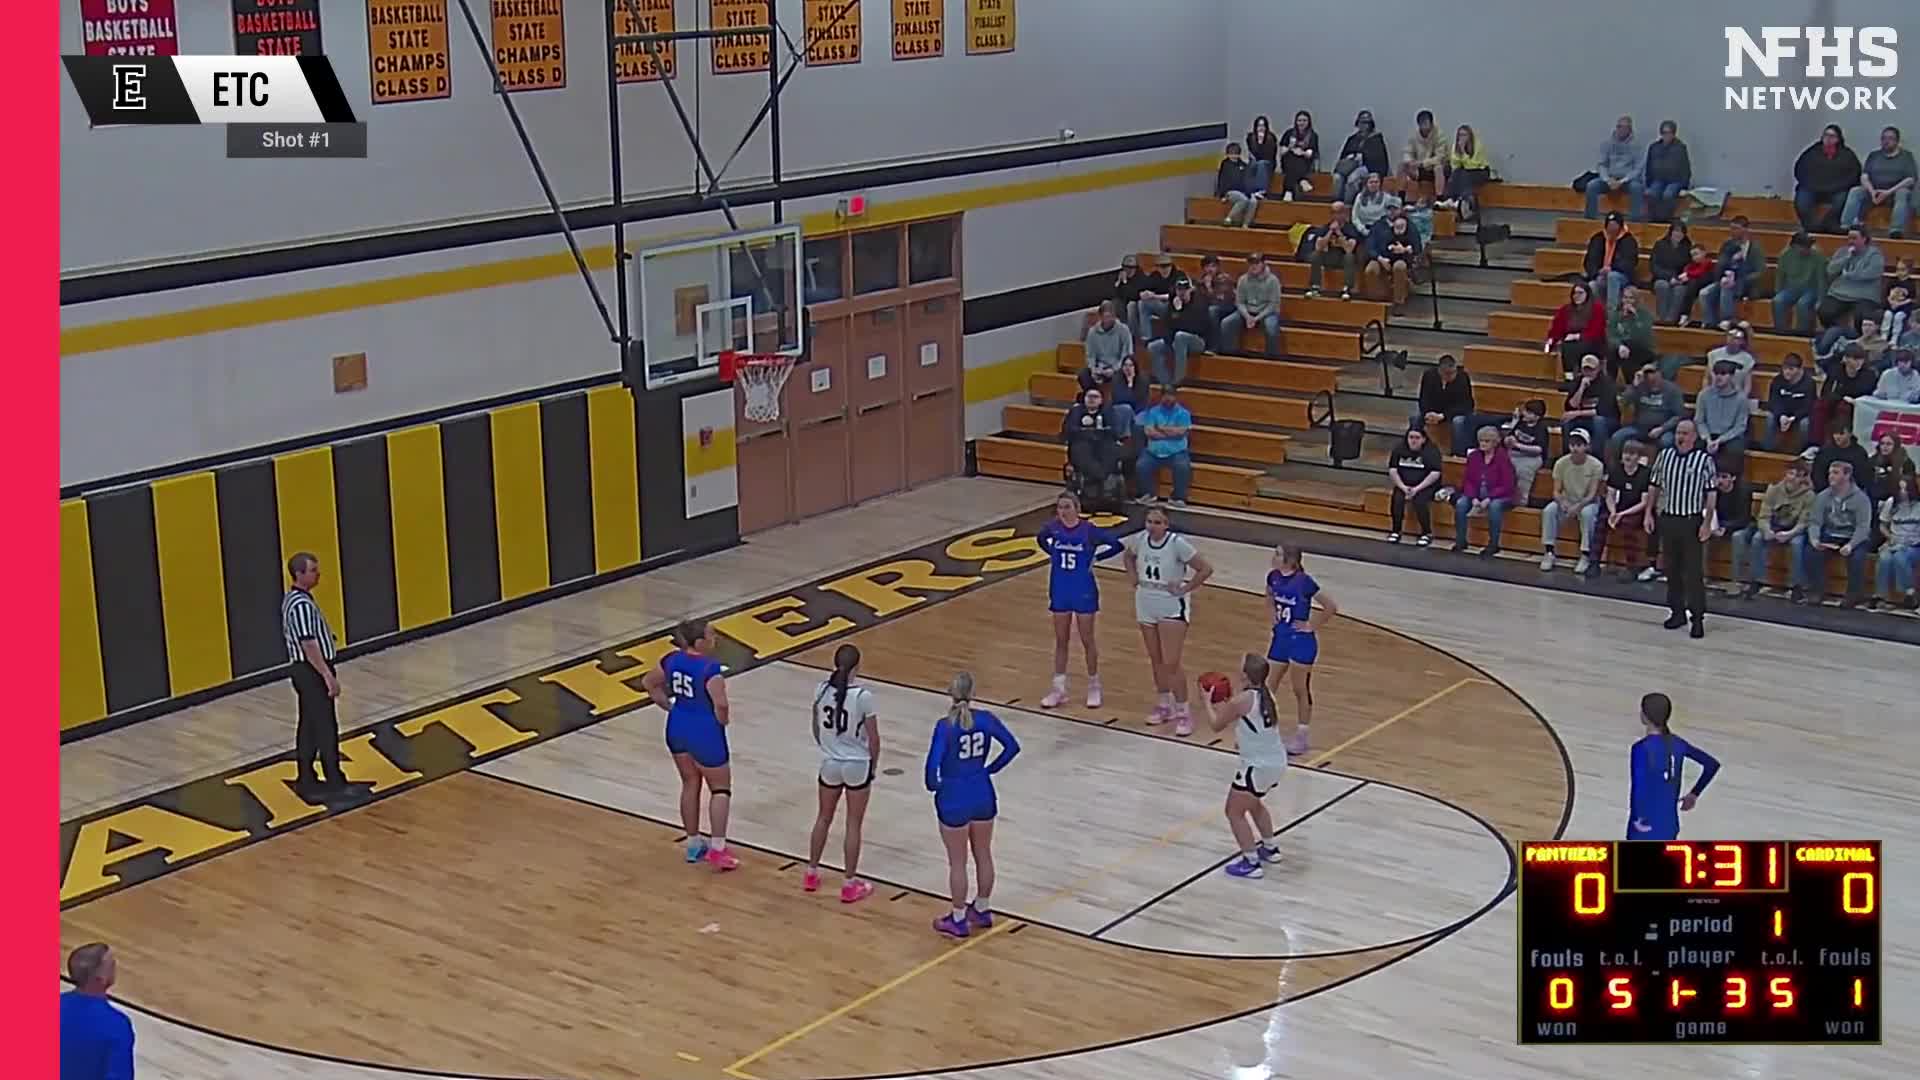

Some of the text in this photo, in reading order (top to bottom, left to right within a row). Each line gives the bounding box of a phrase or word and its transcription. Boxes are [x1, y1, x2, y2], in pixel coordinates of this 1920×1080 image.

[371, 5, 443, 25] BASKETBALL
[494, 0, 559, 18] BASKETBALL
[818, 5, 846, 21] STATE
[905, 0, 930, 17] STATE
[236, 13, 317, 34] BASKETBALL
[726, 10, 757, 27] STATE
[85, 17, 174, 42] BASKETBALL
[509, 22, 546, 41] STATE
[808, 24, 857, 41] FINALIST
[895, 20, 940, 36] FINALIST
[257, 36, 301, 55] STATE
[389, 29, 429, 49] STATE
[615, 40, 671, 56] INALST
[895, 37, 941, 55] CLASS D
[496, 44, 561, 65] CHAMPS
[716, 51, 769, 68] CLASS D
[809, 44, 857, 61] CLASS D
[375, 52, 445, 73] CHAMPS
[615, 59, 672, 77] CLASS D
[498, 67, 561, 86] CLASS D
[375, 77, 446, 96] CLASS D
[1060, 552, 1077, 570] 15
[1145, 564, 1161, 580] 44
[672, 670, 695, 698] 25
[822, 704, 849, 734] 30
[958, 731, 985, 759] 32
